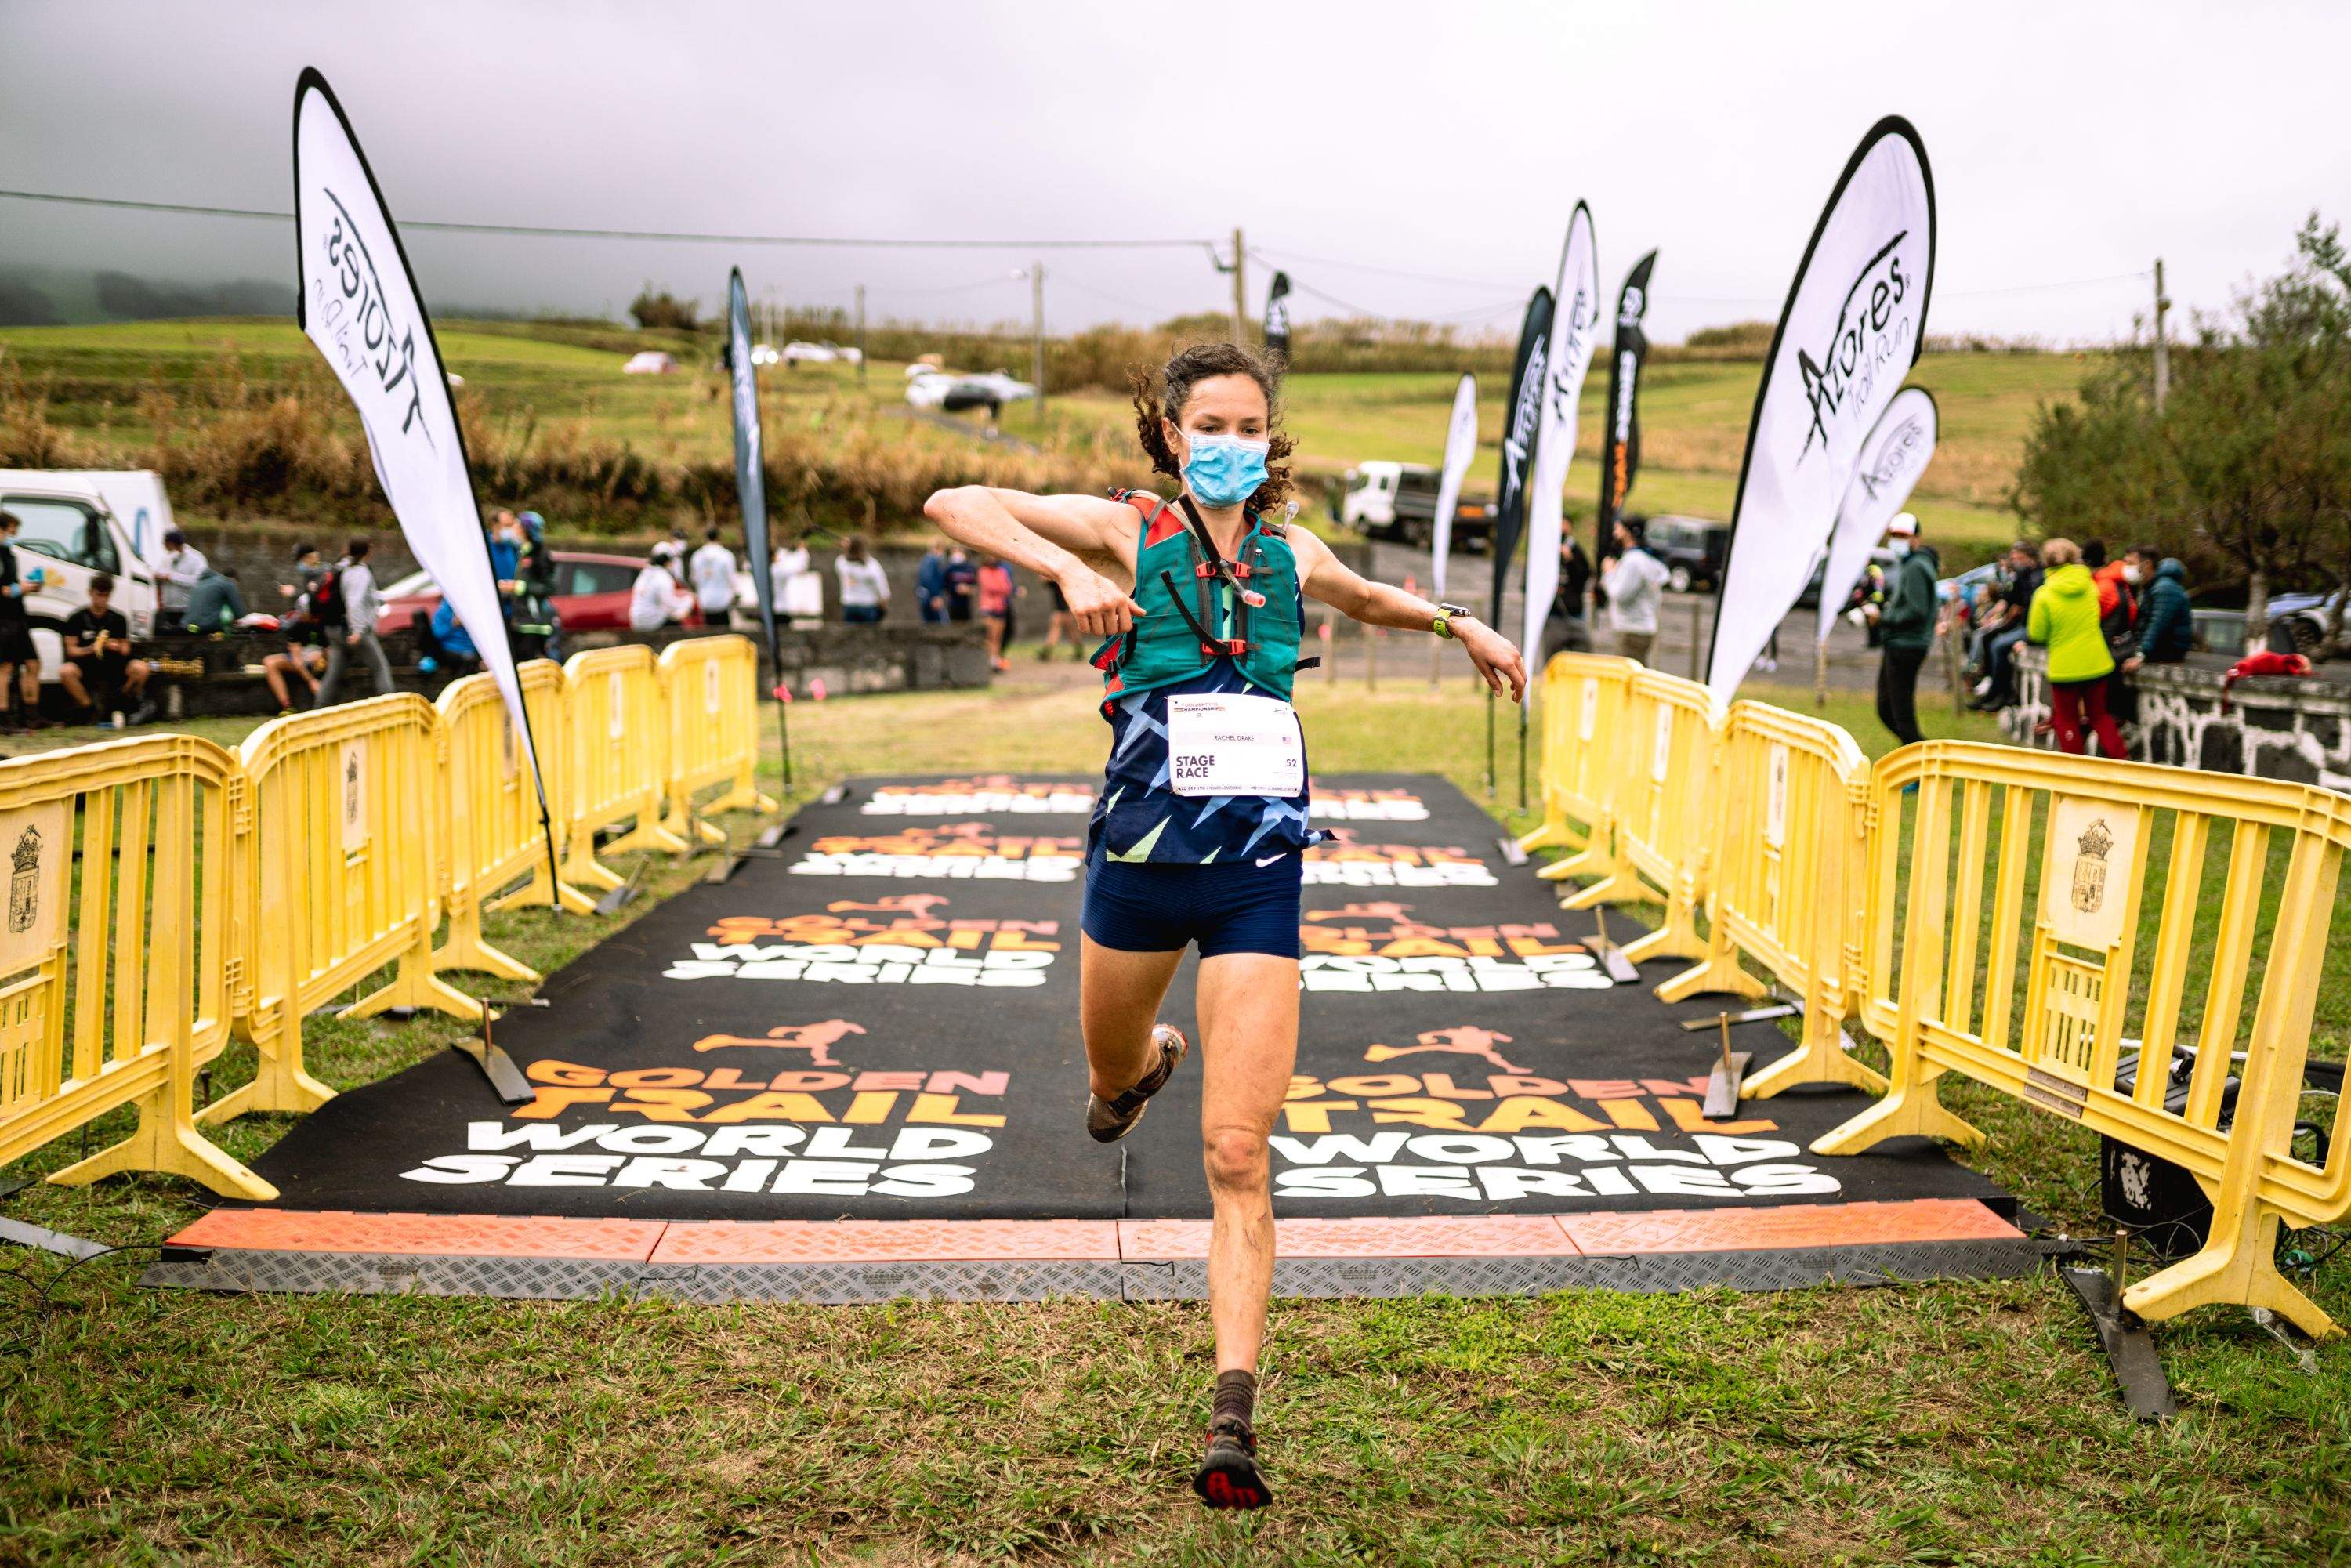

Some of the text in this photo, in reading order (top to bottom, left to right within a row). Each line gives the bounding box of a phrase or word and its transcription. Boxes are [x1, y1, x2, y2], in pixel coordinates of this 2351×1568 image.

[1795, 229, 1908, 470] Azores
[1176, 755, 1215, 766] STAGE
[1176, 767, 1208, 778] RACE
[1286, 759, 1297, 767] 52
[690, 943, 1056, 969] WORLD
[1299, 969, 1614, 992] ERIES
[526, 1059, 1011, 1095] GOLDEN
[510, 1086, 1008, 1128] TRAIL
[1281, 1095, 1780, 1135] TRAIL
[468, 1121, 994, 1160] WORLD
[1267, 1131, 1801, 1166] WORLD
[398, 1154, 978, 1197] SERIES
[1273, 1164, 1842, 1201] SERIES
